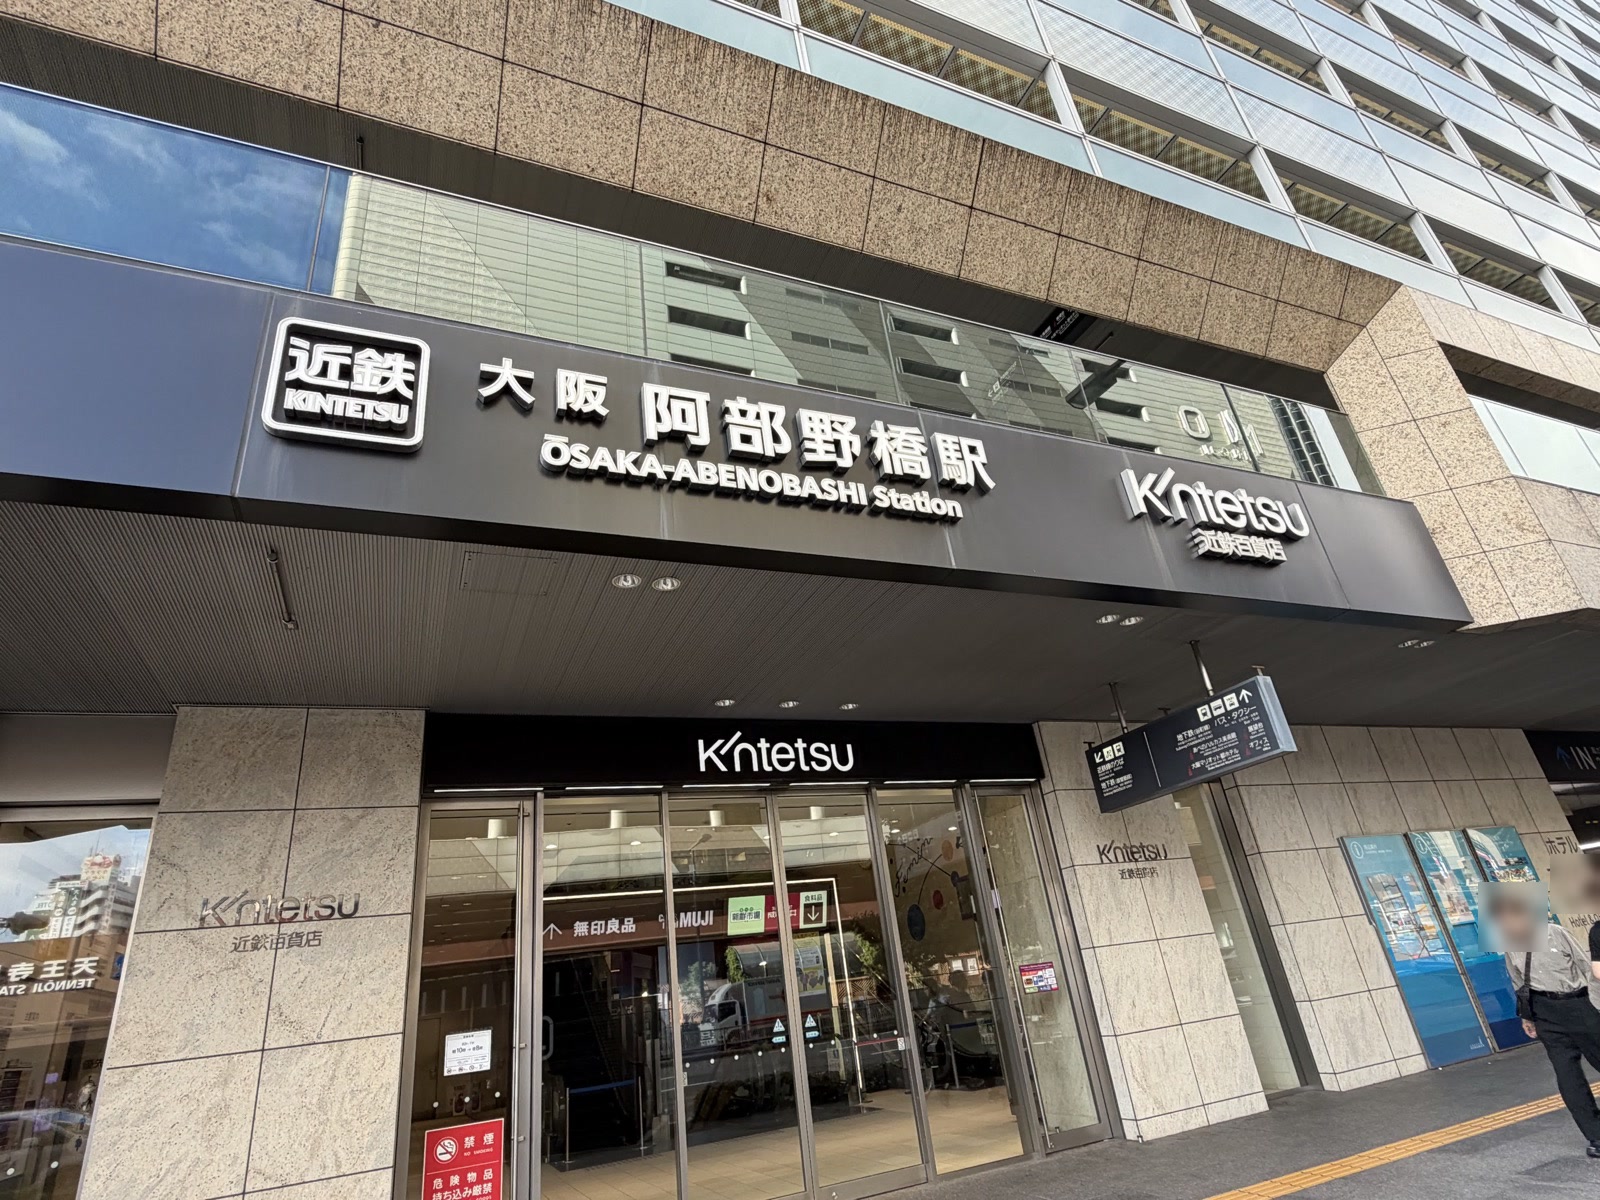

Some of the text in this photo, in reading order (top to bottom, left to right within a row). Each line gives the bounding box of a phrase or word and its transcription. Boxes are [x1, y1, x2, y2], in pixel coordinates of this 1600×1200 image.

[285, 336, 415, 400] 近鉄
[283, 388, 410, 429] KINTETSU
[871, 485, 964, 521] Station
[1191, 528, 1287, 563] 近鉄百貨店
[1546, 836, 1579, 854] ホテル
[573, 917, 636, 936] 無印良品
[679, 910, 714, 928] MUJI
[229, 930, 323, 953] 近鉄百貨店
[464, 1132, 495, 1149] 禁煙
[433, 1168, 493, 1190] 危険物品
